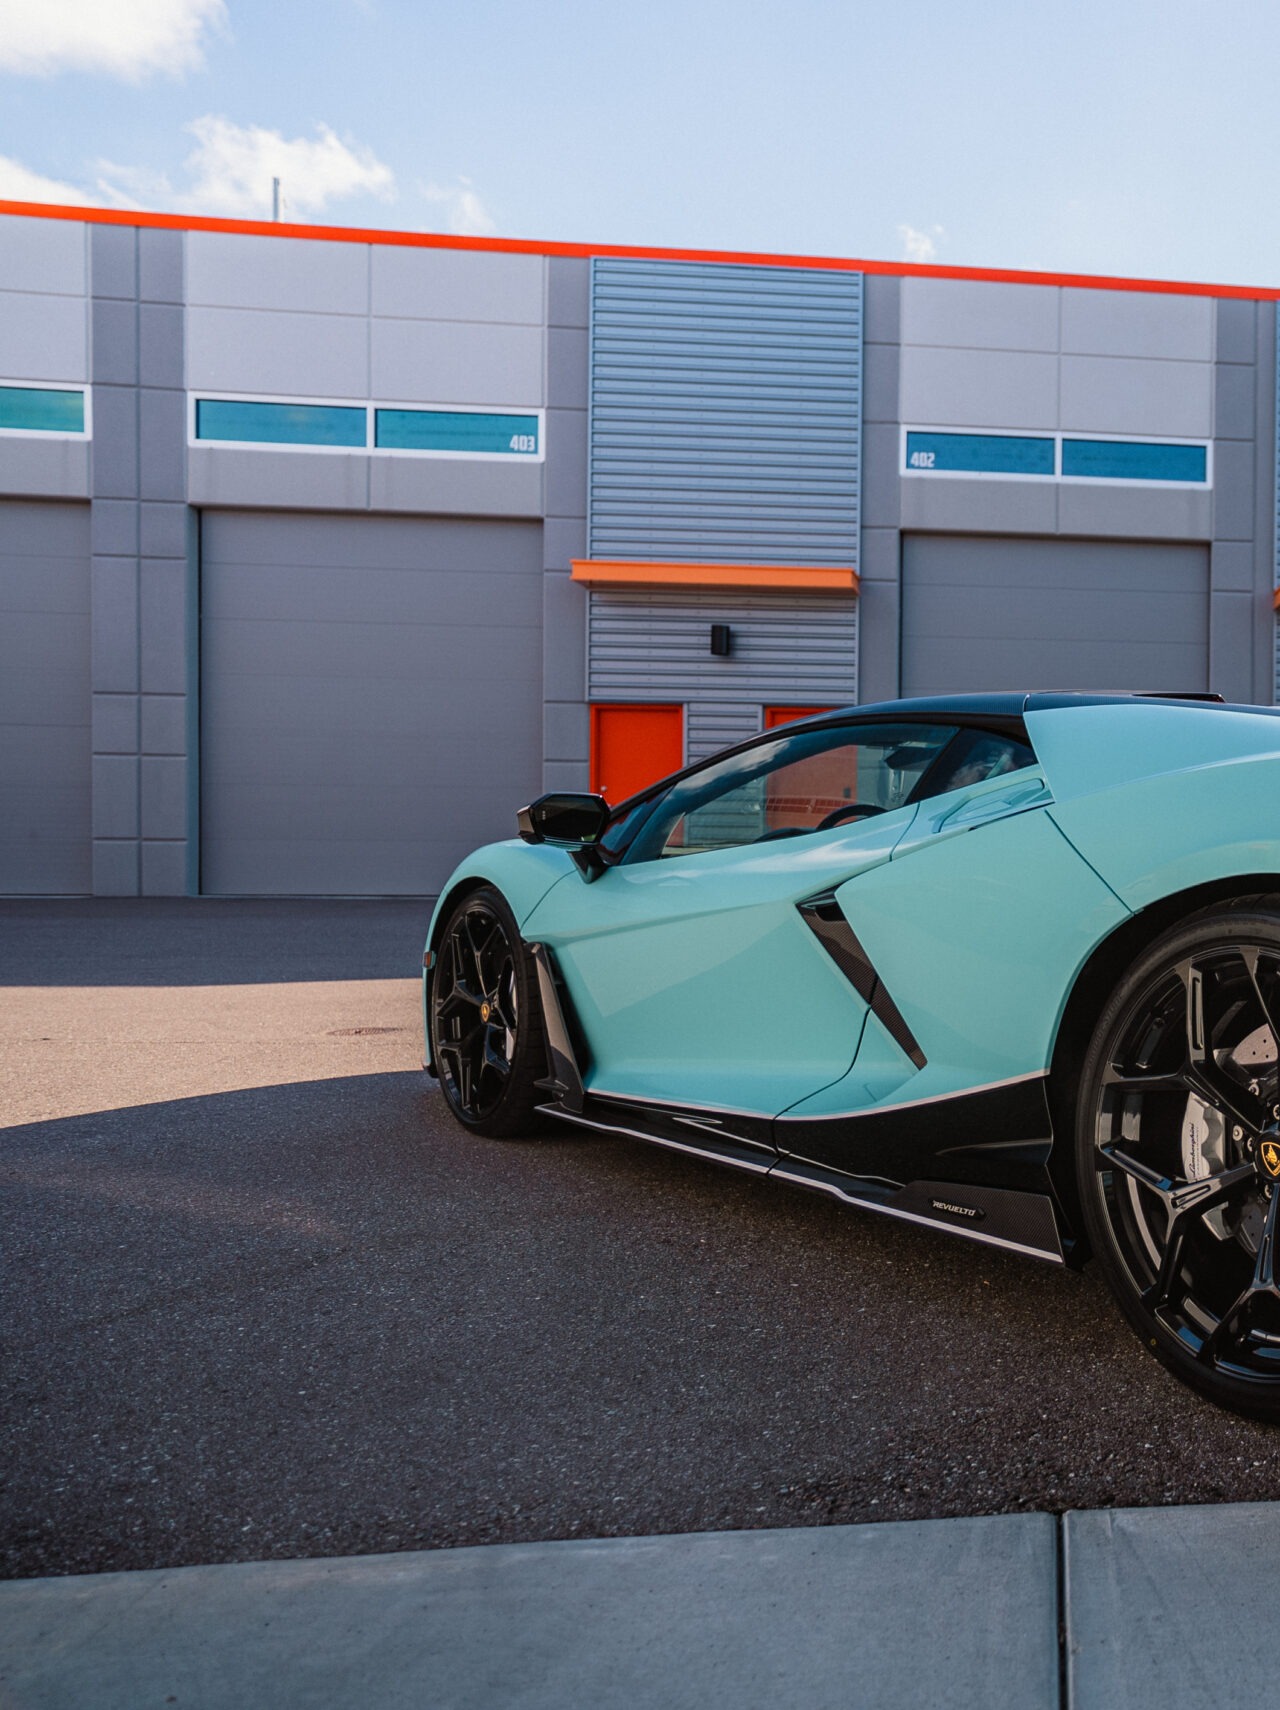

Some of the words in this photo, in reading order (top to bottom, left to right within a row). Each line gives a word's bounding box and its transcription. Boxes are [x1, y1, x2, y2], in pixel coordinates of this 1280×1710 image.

[509, 434, 535, 452] 403
[910, 451, 936, 468] 402
[932, 1200, 976, 1217] REVUELTO
